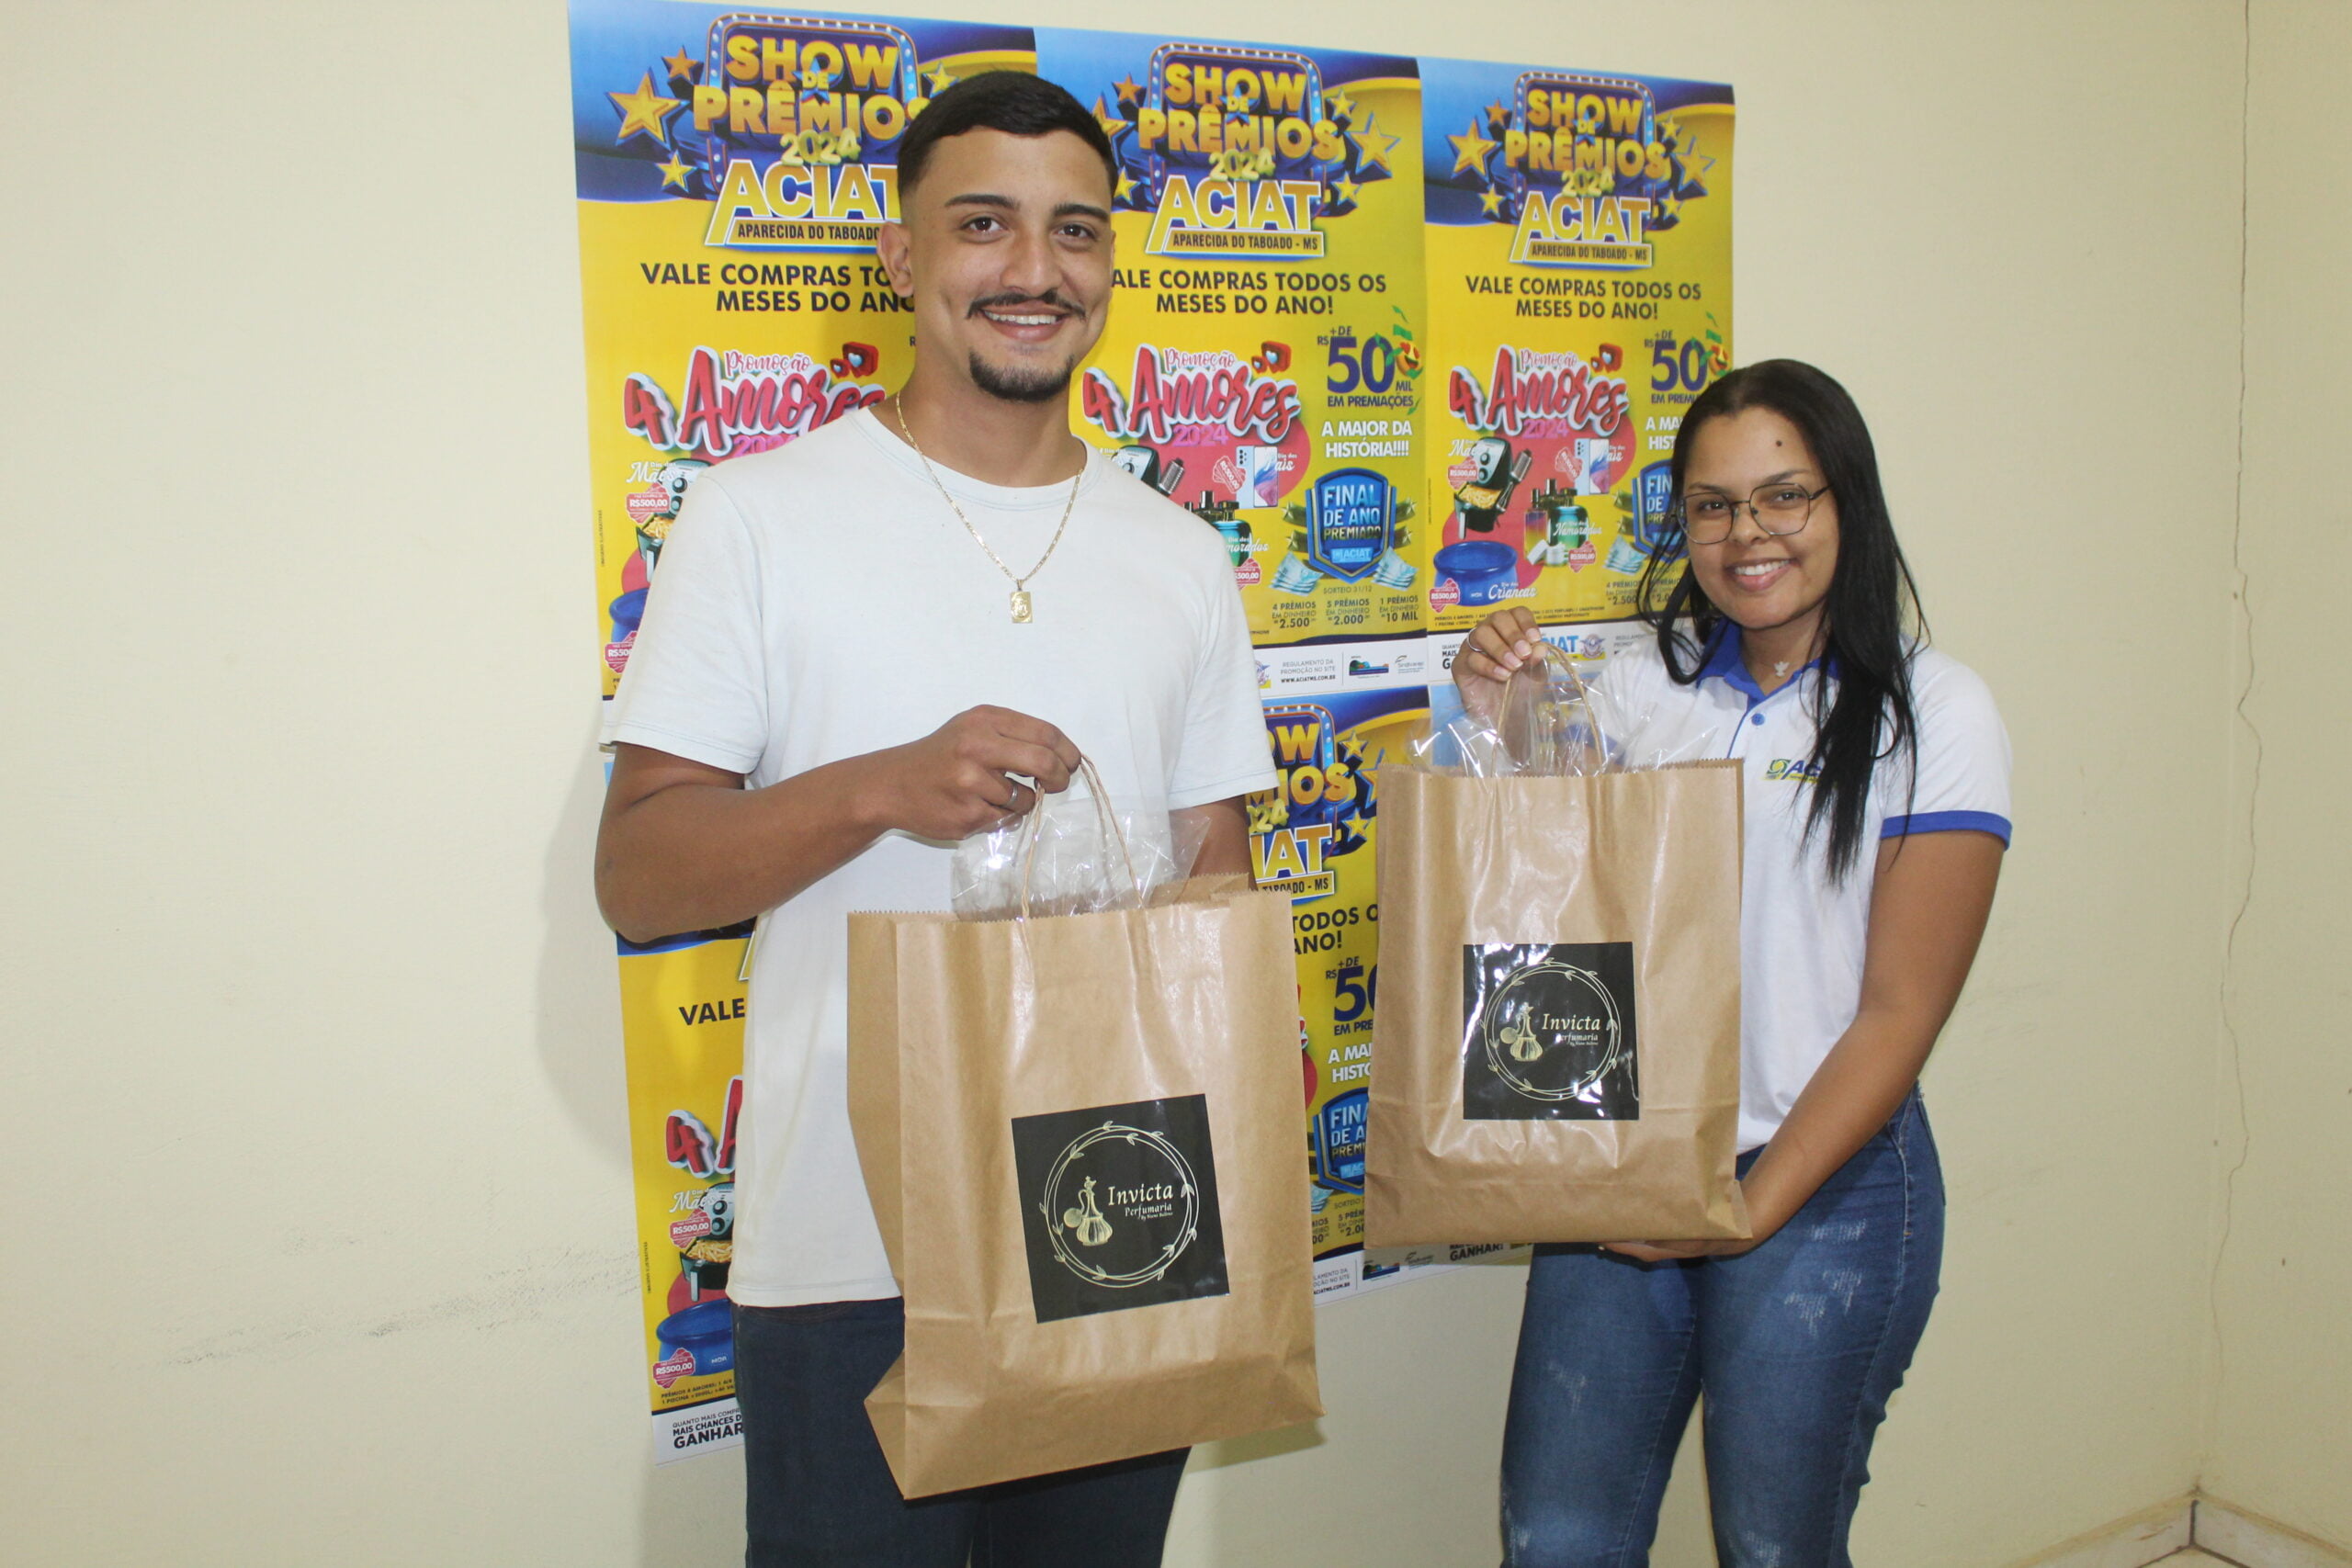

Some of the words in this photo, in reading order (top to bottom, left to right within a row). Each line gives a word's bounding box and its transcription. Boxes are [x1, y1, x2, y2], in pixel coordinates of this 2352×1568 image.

[726, 35, 899, 90] SHOW
[801, 71, 829, 89] DE
[1165, 63, 1307, 111] SHOW
[1227, 97, 1249, 112] DE
[1527, 89, 1644, 135] SHOW
[1138, 104, 1341, 162] PRÊMIOS
[1577, 119, 1596, 135] DE
[779, 128, 862, 167] 2024
[1505, 126, 1669, 179] PRÊMIOS
[1208, 149, 1276, 182] 2024
[1562, 166, 1615, 198] 2024
[705, 159, 902, 246] ACIAT
[1146, 175, 1321, 254] ACIAT
[738, 223, 805, 240] APARECIDA
[808, 225, 825, 240] DO
[1510, 191, 1652, 264] ACIAT
[1173, 234, 1228, 248] APARECIDA
[1231, 235, 1245, 249] DO
[1249, 236, 1293, 249] TABOADO
[1303, 238, 1317, 250] MS
[1532, 243, 1577, 257] APARECIDA
[1578, 245, 1589, 258] DO
[1592, 246, 1628, 260] TABOADO
[1635, 248, 1647, 261] MS
[640, 264, 711, 285] VALE
[719, 264, 852, 288] COMPRAS
[1112, 269, 1150, 288] ALE
[1159, 270, 1268, 290] COMPRAS
[1275, 273, 1351, 292] TODOS
[1358, 275, 1386, 293] OS
[1465, 275, 1514, 294] VALE
[1520, 276, 1606, 297] COMPRAS
[1611, 279, 1673, 299] TODOS
[1679, 283, 1702, 299] OS
[716, 289, 801, 313] MESES
[810, 291, 850, 313] DO
[1156, 293, 1227, 313] MESES
[1235, 295, 1268, 314] DO
[1276, 295, 1334, 315] ANO!
[1516, 299, 1573, 318] MESES
[1578, 300, 1606, 319] DO
[1611, 301, 1658, 320] ANO!
[725, 350, 810, 378] Promoção
[1164, 348, 1237, 372] Promoção
[1328, 336, 1396, 393] 50
[1396, 380, 1413, 392] MIL
[1521, 349, 1577, 371] Promoção
[1651, 339, 1709, 392] 50
[1082, 369, 1116, 434] 4
[1127, 345, 1301, 443] Amores
[1328, 395, 1344, 407] EM
[1348, 391, 1414, 410] PREMIAÇÕES
[1449, 368, 1476, 426] 4
[1485, 346, 1631, 436] Amores
[1651, 393, 1665, 404] EM
[624, 375, 665, 446] 4
[1321, 421, 1334, 436] A
[1339, 420, 1388, 437] MAIOR
[1392, 420, 1413, 436] DA
[1522, 417, 1569, 438] 2024
[1645, 416, 1657, 431] A
[1171, 423, 1229, 448] 2024
[1646, 475, 1673, 494] FIN
[1324, 484, 1381, 508] FINAL
[1646, 496, 1663, 513] DE
[1324, 508, 1344, 527] DE
[1348, 507, 1381, 526] ANO
[1323, 526, 1382, 541] PREMIADO
[1323, 585, 1352, 594] SORTEIO
[1353, 584, 1373, 593] 31/12
[1281, 602, 1317, 610] PRÊMIOS
[1334, 598, 1370, 608] PRÊMIOS
[1387, 595, 1419, 604] PRÊMIOS
[1336, 607, 1370, 615] DINHEIRO
[1280, 617, 1310, 629] 2.500
[1334, 615, 1363, 626] 2.000
[1386, 613, 1398, 623] 10
[1402, 611, 1419, 622] MIL
[1250, 823, 1333, 883] IAT
[1315, 878, 1329, 892] MS
[679, 998, 745, 1026] VALE
[1541, 1013, 1600, 1031] Invicta
[1334, 1023, 1351, 1036] EM
[1556, 1032, 1599, 1044] erfumaria
[1329, 1049, 1340, 1064] A
[666, 1113, 707, 1175] 4
[1331, 1128, 1351, 1147] DE
[1107, 1182, 1174, 1206] Invicta
[1125, 1201, 1173, 1220] Perfumaria
[673, 1417, 699, 1428] QUANTO
[701, 1413, 716, 1422] MAIS
[673, 1425, 694, 1437] MAIS
[695, 1416, 733, 1431] CHANCES
[673, 1422, 743, 1449] GANHAR
